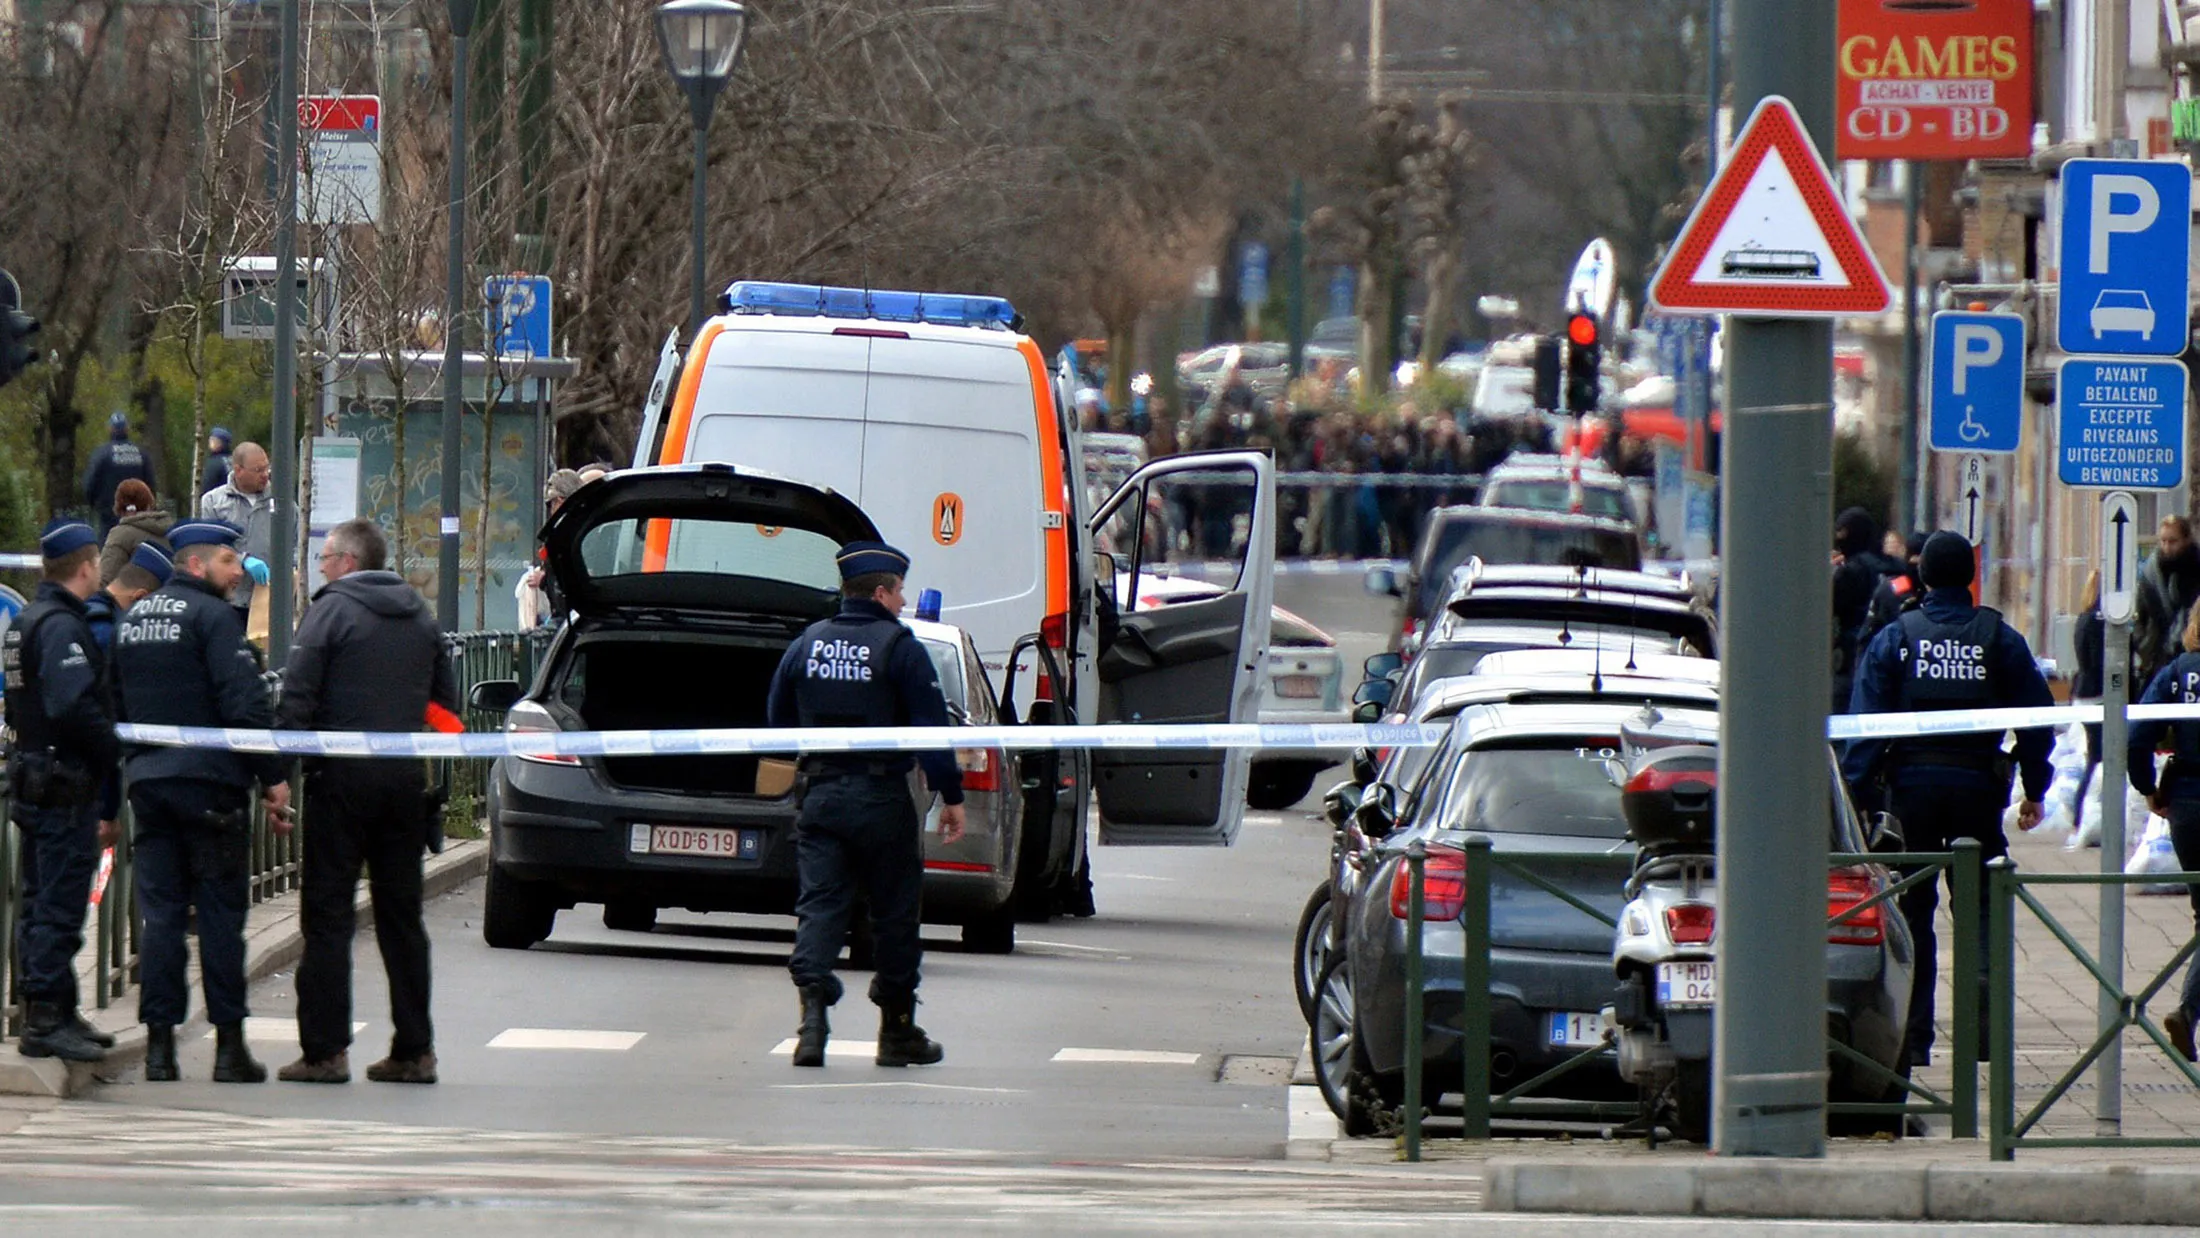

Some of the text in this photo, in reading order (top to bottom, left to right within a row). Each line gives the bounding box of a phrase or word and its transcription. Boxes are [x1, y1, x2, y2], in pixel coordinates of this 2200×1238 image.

[1841, 35, 2018, 79] GAMES
[1867, 83, 1920, 100] ACHAT
[1936, 83, 1990, 100] VENTE
[1848, 107, 1912, 140] CD
[1951, 107, 2009, 140] BD
[2089, 174, 2160, 274] P
[1953, 324, 2003, 395] P
[2095, 366, 2148, 382] PAYANT
[2085, 386, 2158, 402] BETALEND
[2089, 409, 2152, 424] EXCEPTE
[2083, 428, 2159, 444] RIVERAINS
[1970, 458, 1978, 473] 6
[2067, 447, 2174, 463] UITGEZONDERD
[2081, 467, 2159, 482] BEWONERS
[128, 594, 188, 616] Police
[119, 618, 181, 644] Politie
[811, 639, 870, 661] Police
[1919, 639, 1984, 660] Police
[806, 659, 873, 681] Politie
[1916, 659, 1987, 680] Politie
[1687, 983, 1717, 1000] 04
